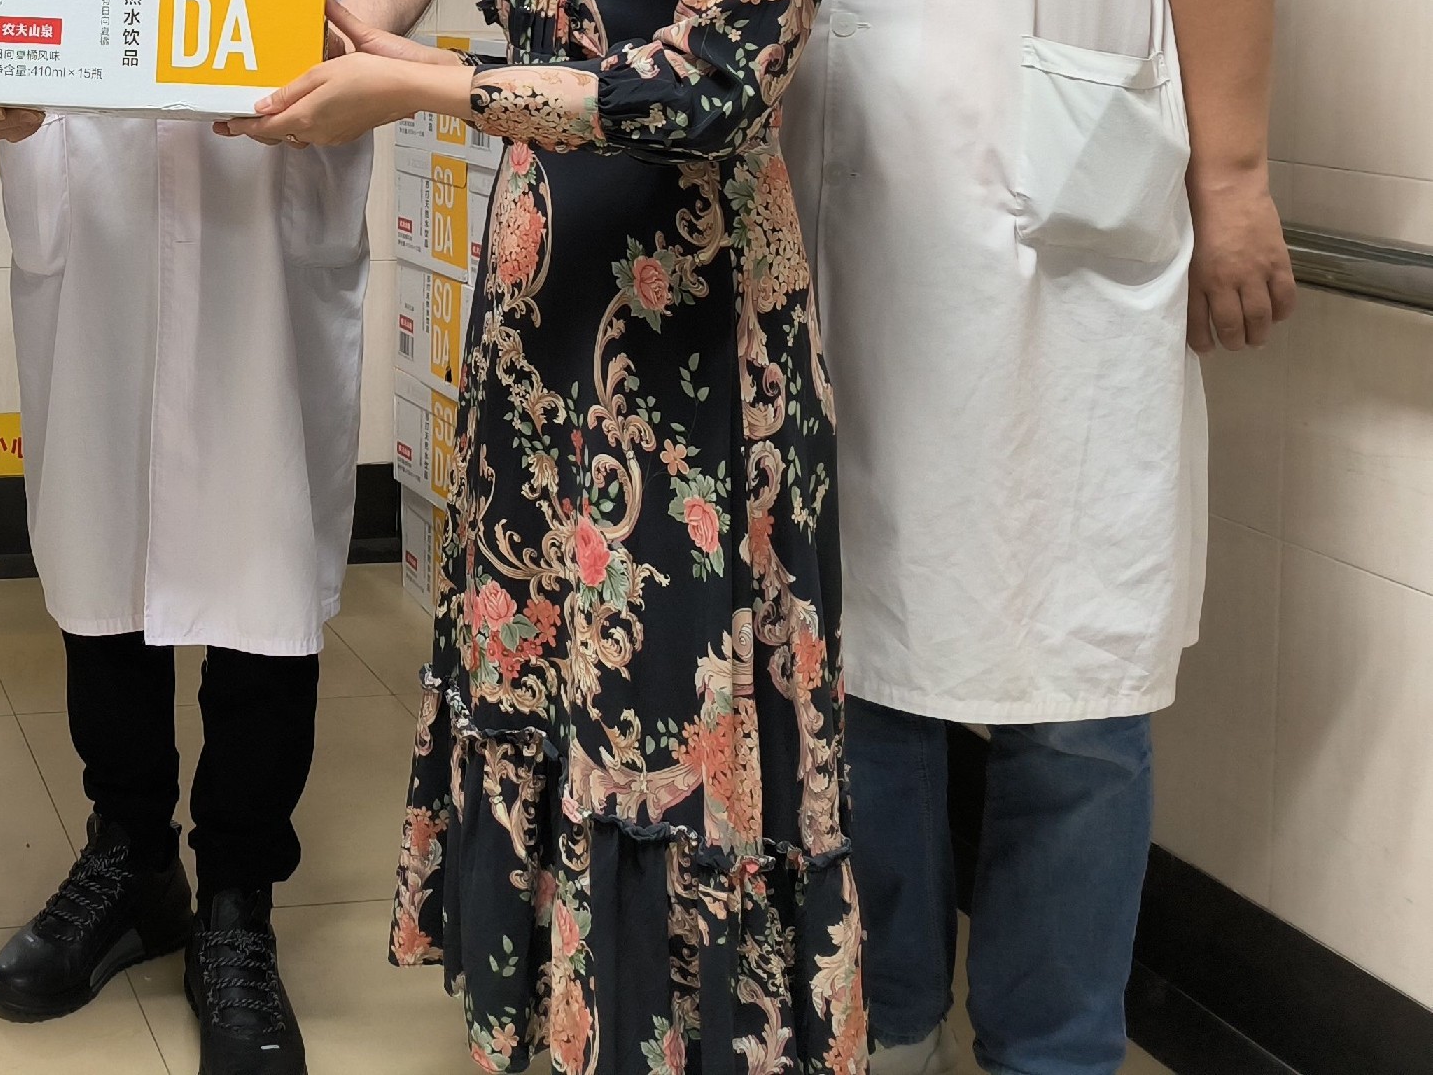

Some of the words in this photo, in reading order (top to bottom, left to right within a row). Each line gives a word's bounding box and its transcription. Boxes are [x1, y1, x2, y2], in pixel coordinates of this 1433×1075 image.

[2, 23, 53, 38] 农夫山泉
[434, 166, 454, 209] SO
[434, 211, 454, 257] DA
[433, 278, 452, 323] SO
[432, 325, 451, 368] DA
[434, 401, 454, 447] SO
